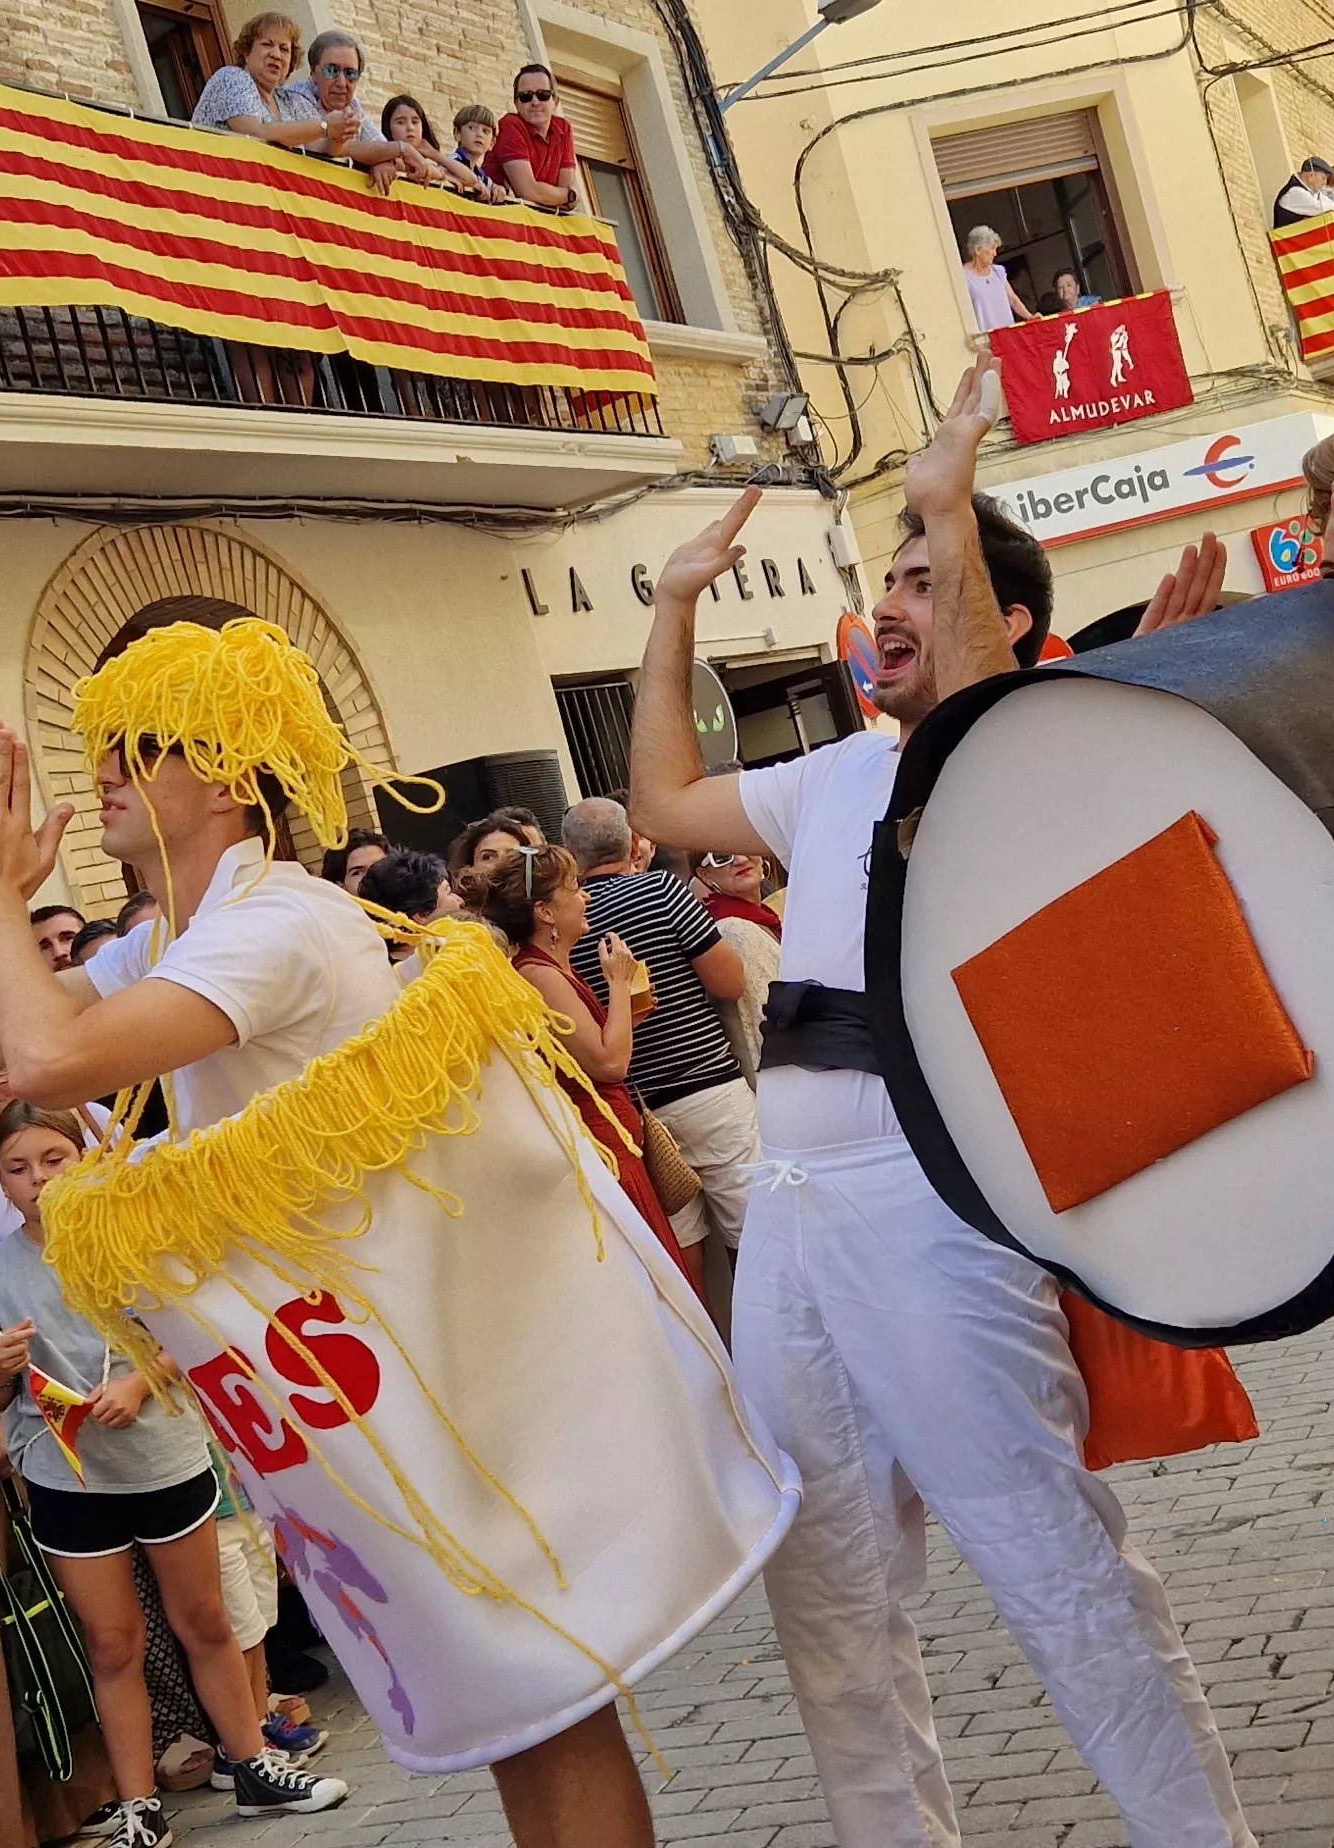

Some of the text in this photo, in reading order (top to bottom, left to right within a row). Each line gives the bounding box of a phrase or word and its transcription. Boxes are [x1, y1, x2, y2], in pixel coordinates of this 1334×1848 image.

[1049, 389, 1156, 425] ALMUDEVAR
[1016, 465, 1170, 523] iberCaja
[520, 565, 595, 617] LA
